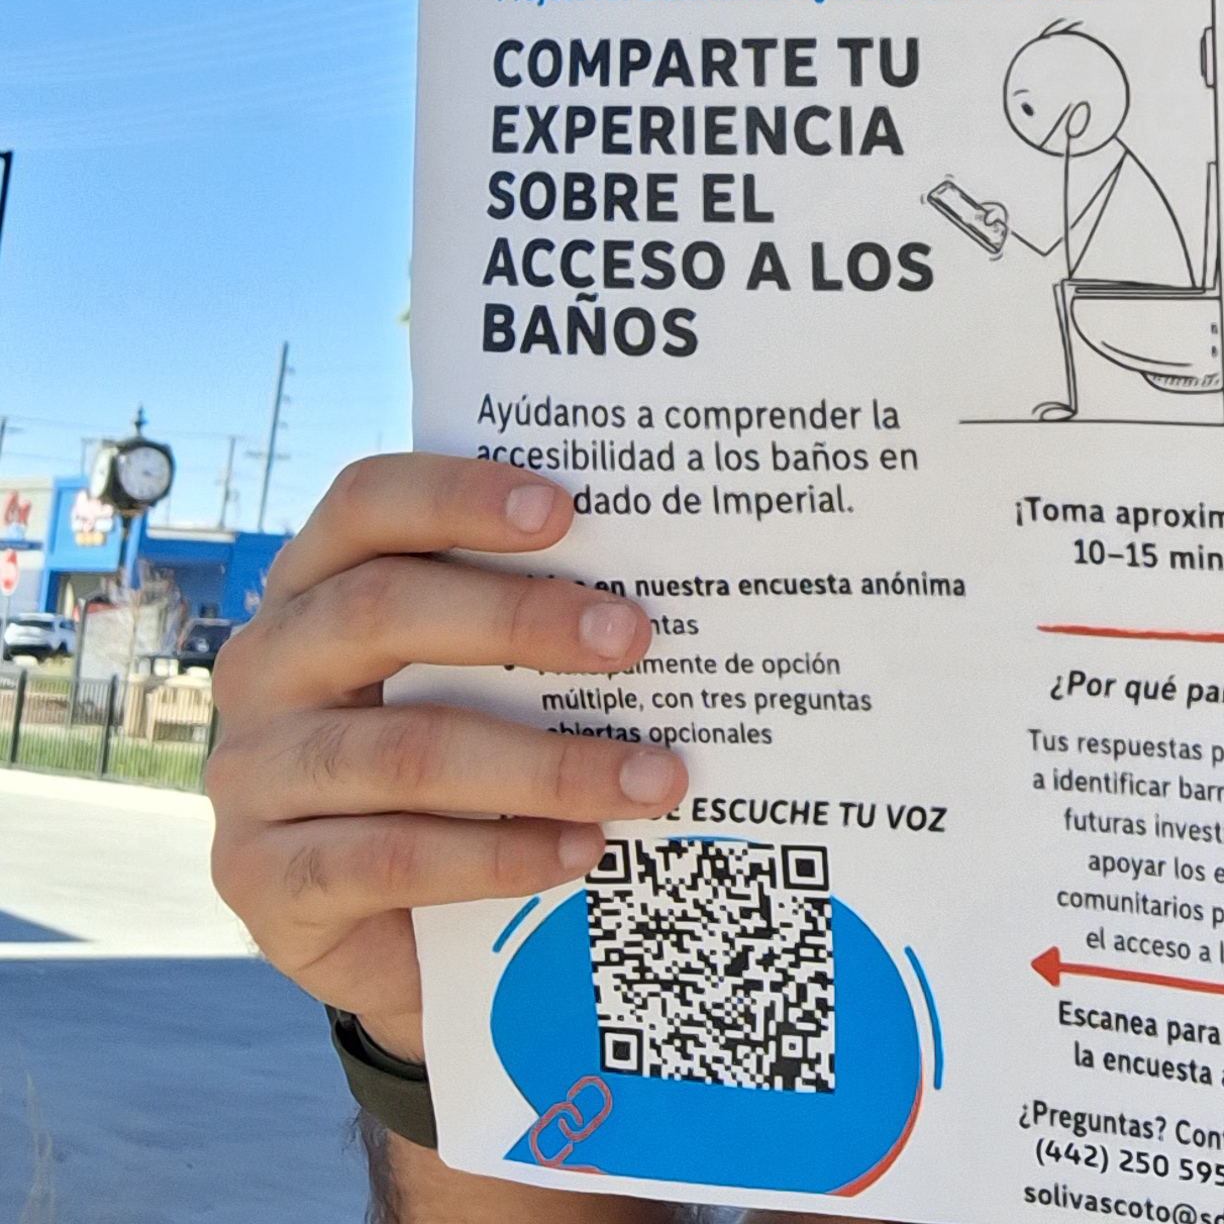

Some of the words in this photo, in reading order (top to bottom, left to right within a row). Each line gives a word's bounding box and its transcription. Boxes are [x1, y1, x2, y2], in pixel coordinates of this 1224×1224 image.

[492, 37, 818, 89] COMPARTE
[836, 36, 920, 89] TU
[491, 104, 905, 157] EXPERIENCIA
[486, 170, 679, 223] SOBRE
[701, 172, 775, 224] EL
[481, 236, 726, 291] ACCESO
[745, 240, 792, 292] A
[810, 241, 935, 293] LOS
[482, 291, 699, 359] BAÑOS
[477, 392, 627, 435] Ayúdanos
[636, 405, 655, 430] a
[664, 398, 863, 439] comprender
[872, 398, 902, 431] la
[476, 438, 676, 473] accesibilidad
[686, 448, 706, 472] a
[714, 440, 761, 472] los
[770, 440, 870, 472] baños
[879, 447, 919, 471] en
[573, 484, 653, 517] dado
[661, 483, 703, 516] de
[712, 483, 854, 523] Imperial.
[1014, 495, 1106, 527] ¡Toma
[634, 575, 731, 599] nuestra
[737, 573, 854, 597] encuesta
[860, 570, 967, 598] anónima
[724, 651, 755, 675] de
[761, 651, 841, 680] opción
[541, 686, 645, 716] múltiple,
[651, 691, 694, 709] con
[700, 688, 747, 710] tres
[753, 689, 873, 717] preguntas
[1049, 669, 1118, 702] ¿Por
[1124, 674, 1178, 707] qué
[547, 722, 642, 744] biertas
[648, 722, 774, 749] opcionales
[1026, 728, 1070, 753] Tus
[1077, 736, 1203, 762] respuestas
[1032, 772, 1046, 790] a
[1052, 767, 1172, 799] identificar
[691, 796, 831, 827] ESCUCHE
[838, 801, 877, 829] TU
[886, 803, 948, 834] VOZ
[1063, 806, 1147, 837] futuras
[1087, 854, 1167, 881] apoyar
[1173, 856, 1206, 882] los
[1056, 890, 1205, 922] comunitarios
[1085, 926, 1107, 951] el
[1113, 934, 1192, 961] acceso
[1198, 944, 1212, 964] a
[1058, 999, 1159, 1038] Escanea
[1166, 1019, 1222, 1047] para
[1073, 1039, 1095, 1069] la
[1102, 1051, 1213, 1087] encuesta
[1018, 1099, 1168, 1142] ¿Preguntas?
[1035, 1137, 1109, 1175] (442)
[1118, 1148, 1170, 1178] 250
